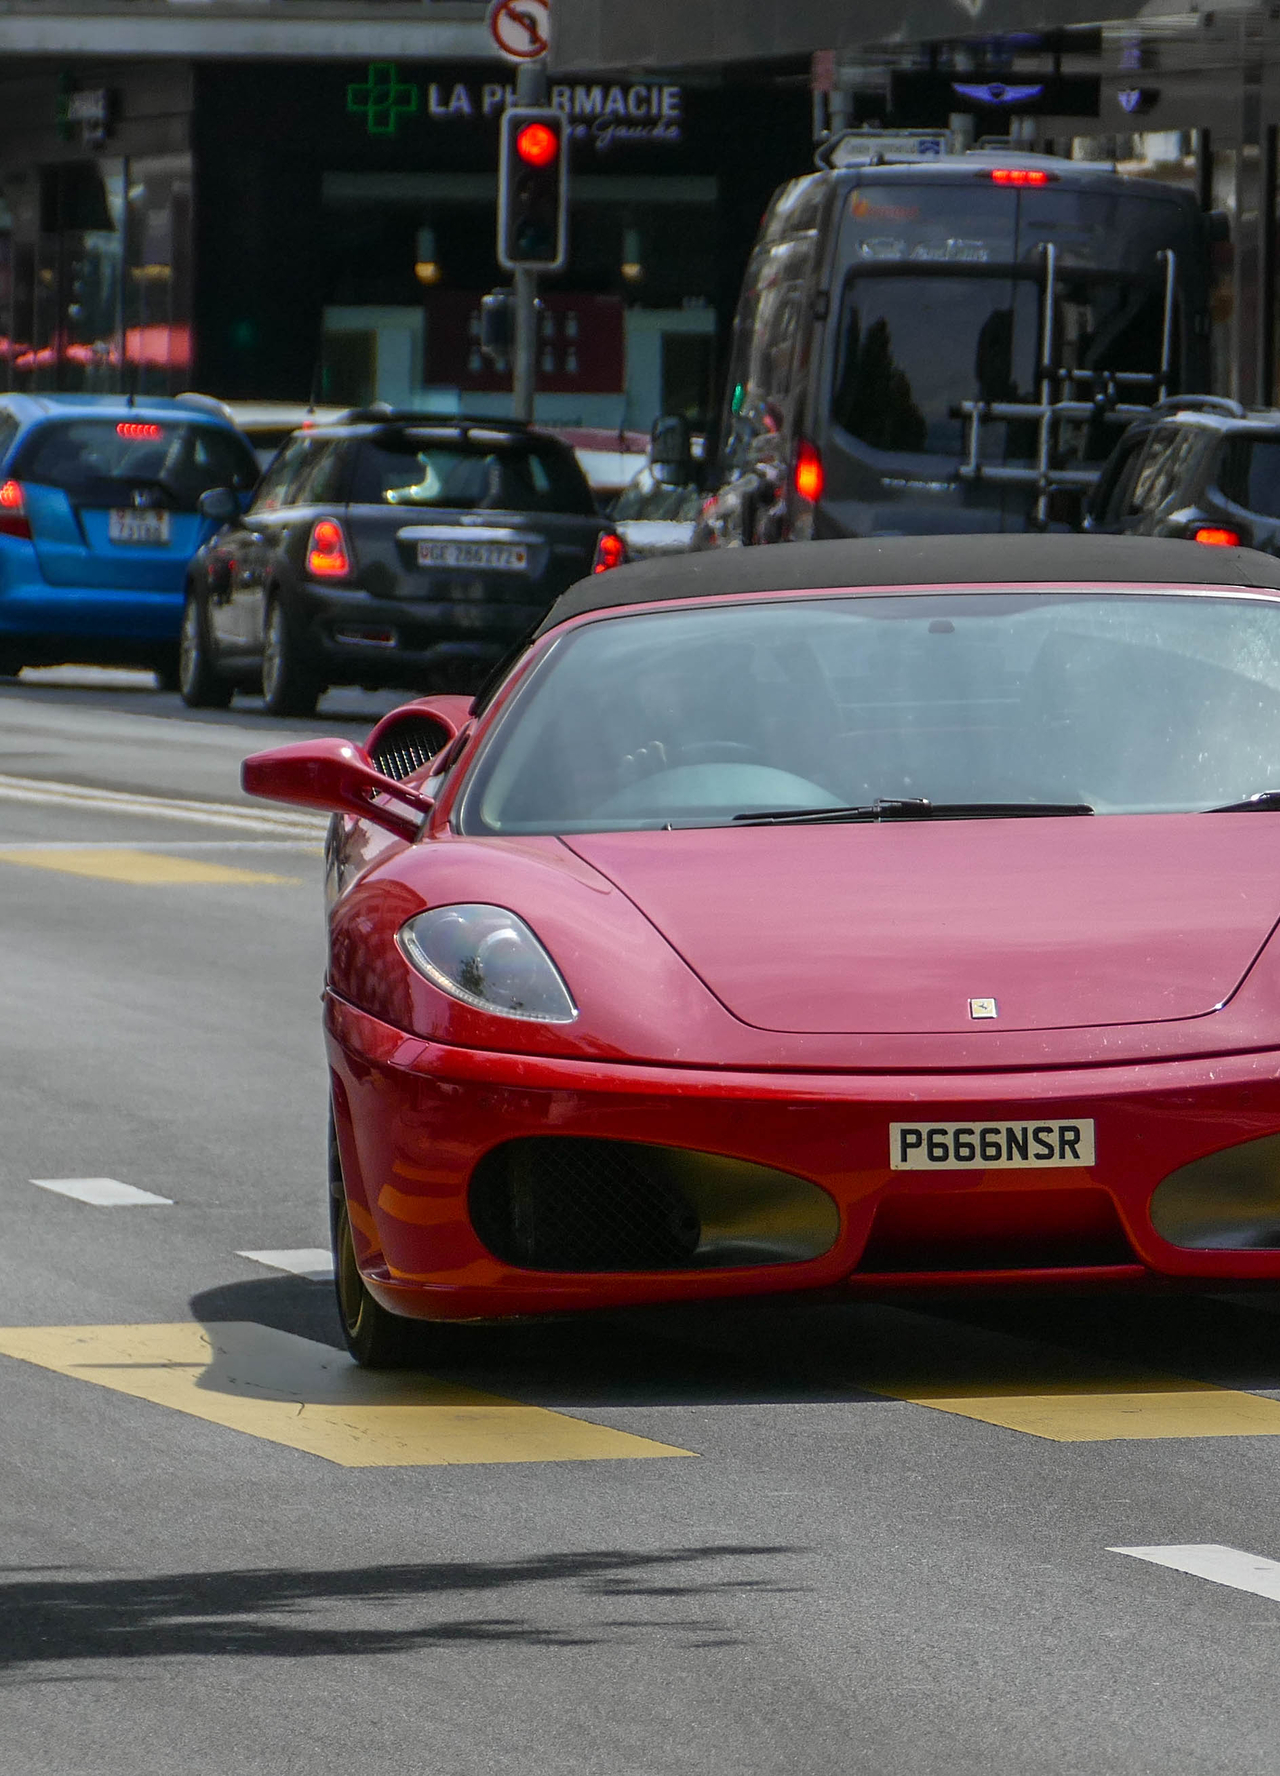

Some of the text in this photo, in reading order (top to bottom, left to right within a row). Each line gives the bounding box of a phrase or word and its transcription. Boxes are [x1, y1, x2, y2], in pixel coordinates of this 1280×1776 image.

[429, 84, 682, 117] LA PHRMACIE
[900, 1125, 1081, 1163] P666NSR
